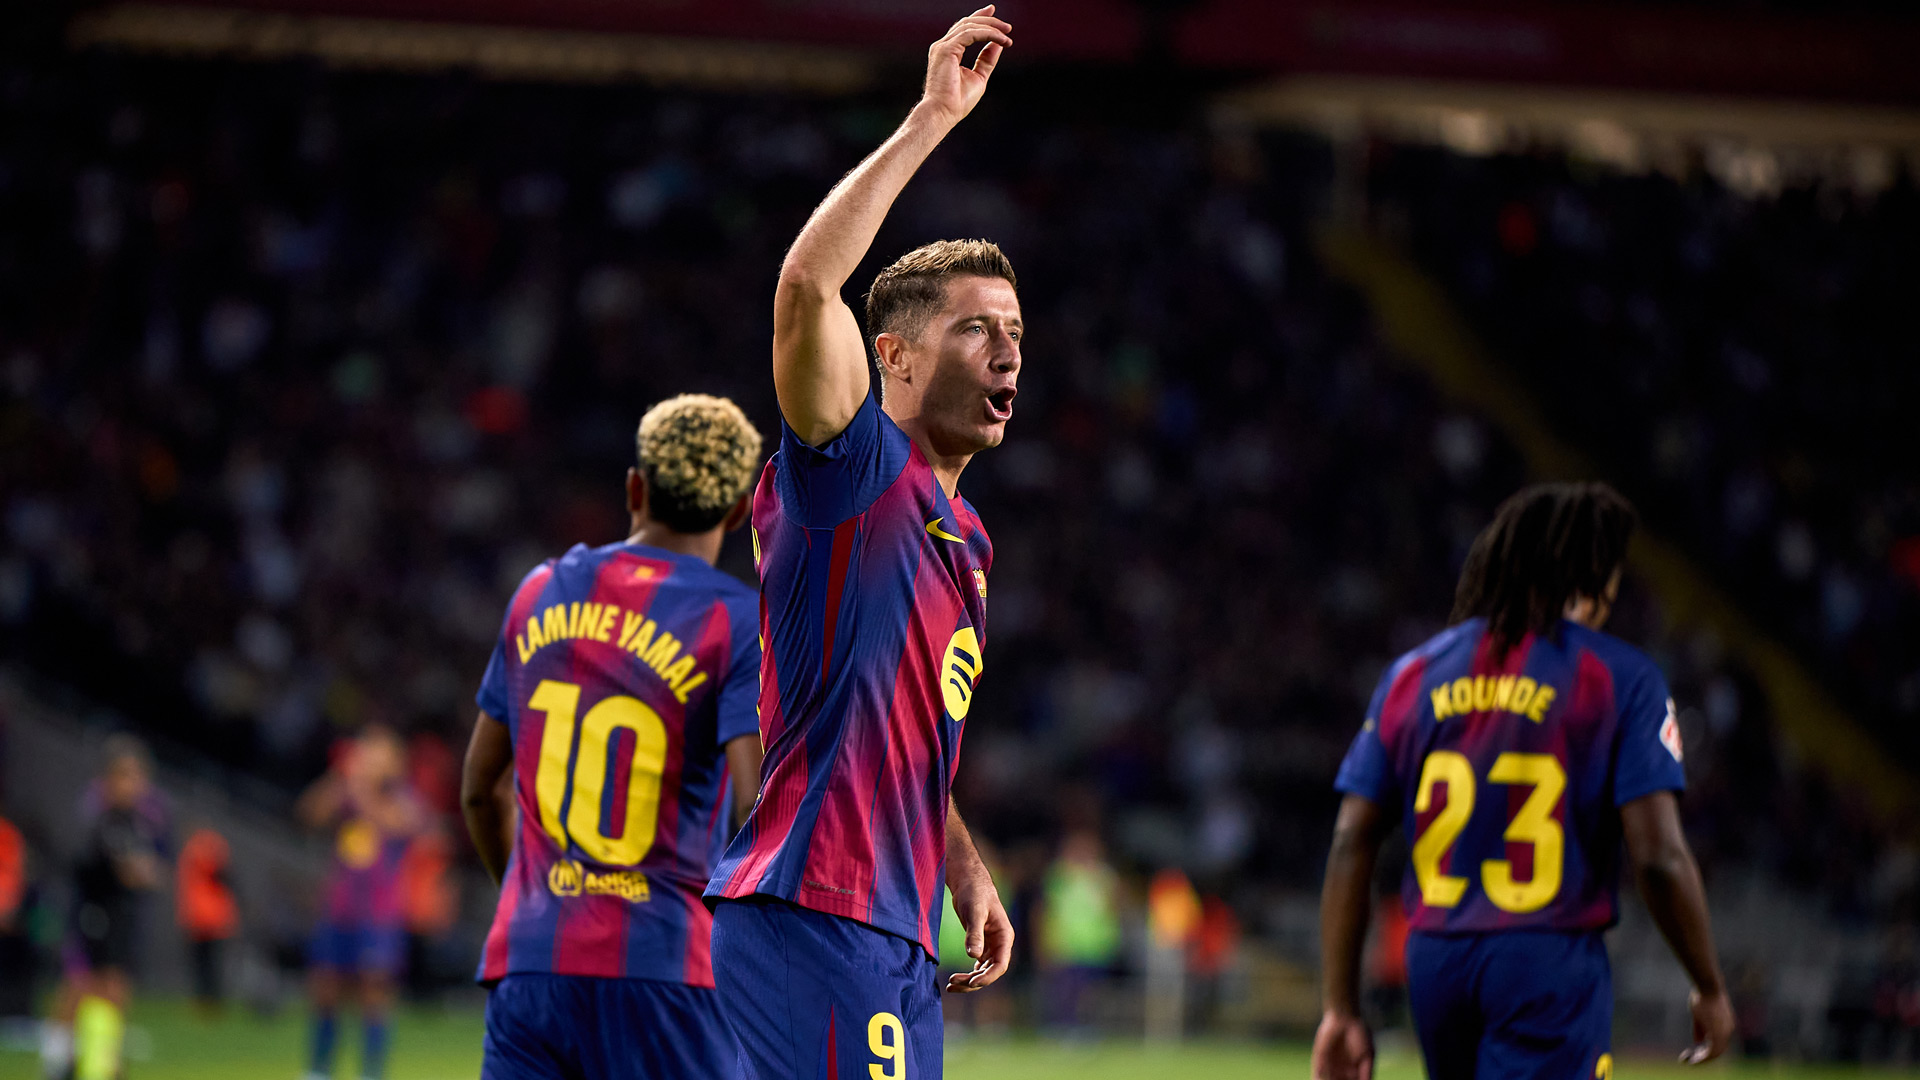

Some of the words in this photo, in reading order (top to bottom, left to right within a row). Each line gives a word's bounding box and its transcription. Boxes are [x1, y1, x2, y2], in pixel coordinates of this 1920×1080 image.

[516, 601, 620, 665] LAMINE
[617, 609, 708, 704] YAMAL
[1430, 673, 1557, 725] KOUNDE
[527, 679, 669, 866] 10
[1412, 749, 1568, 914] 23
[867, 1011, 906, 1080] 9
